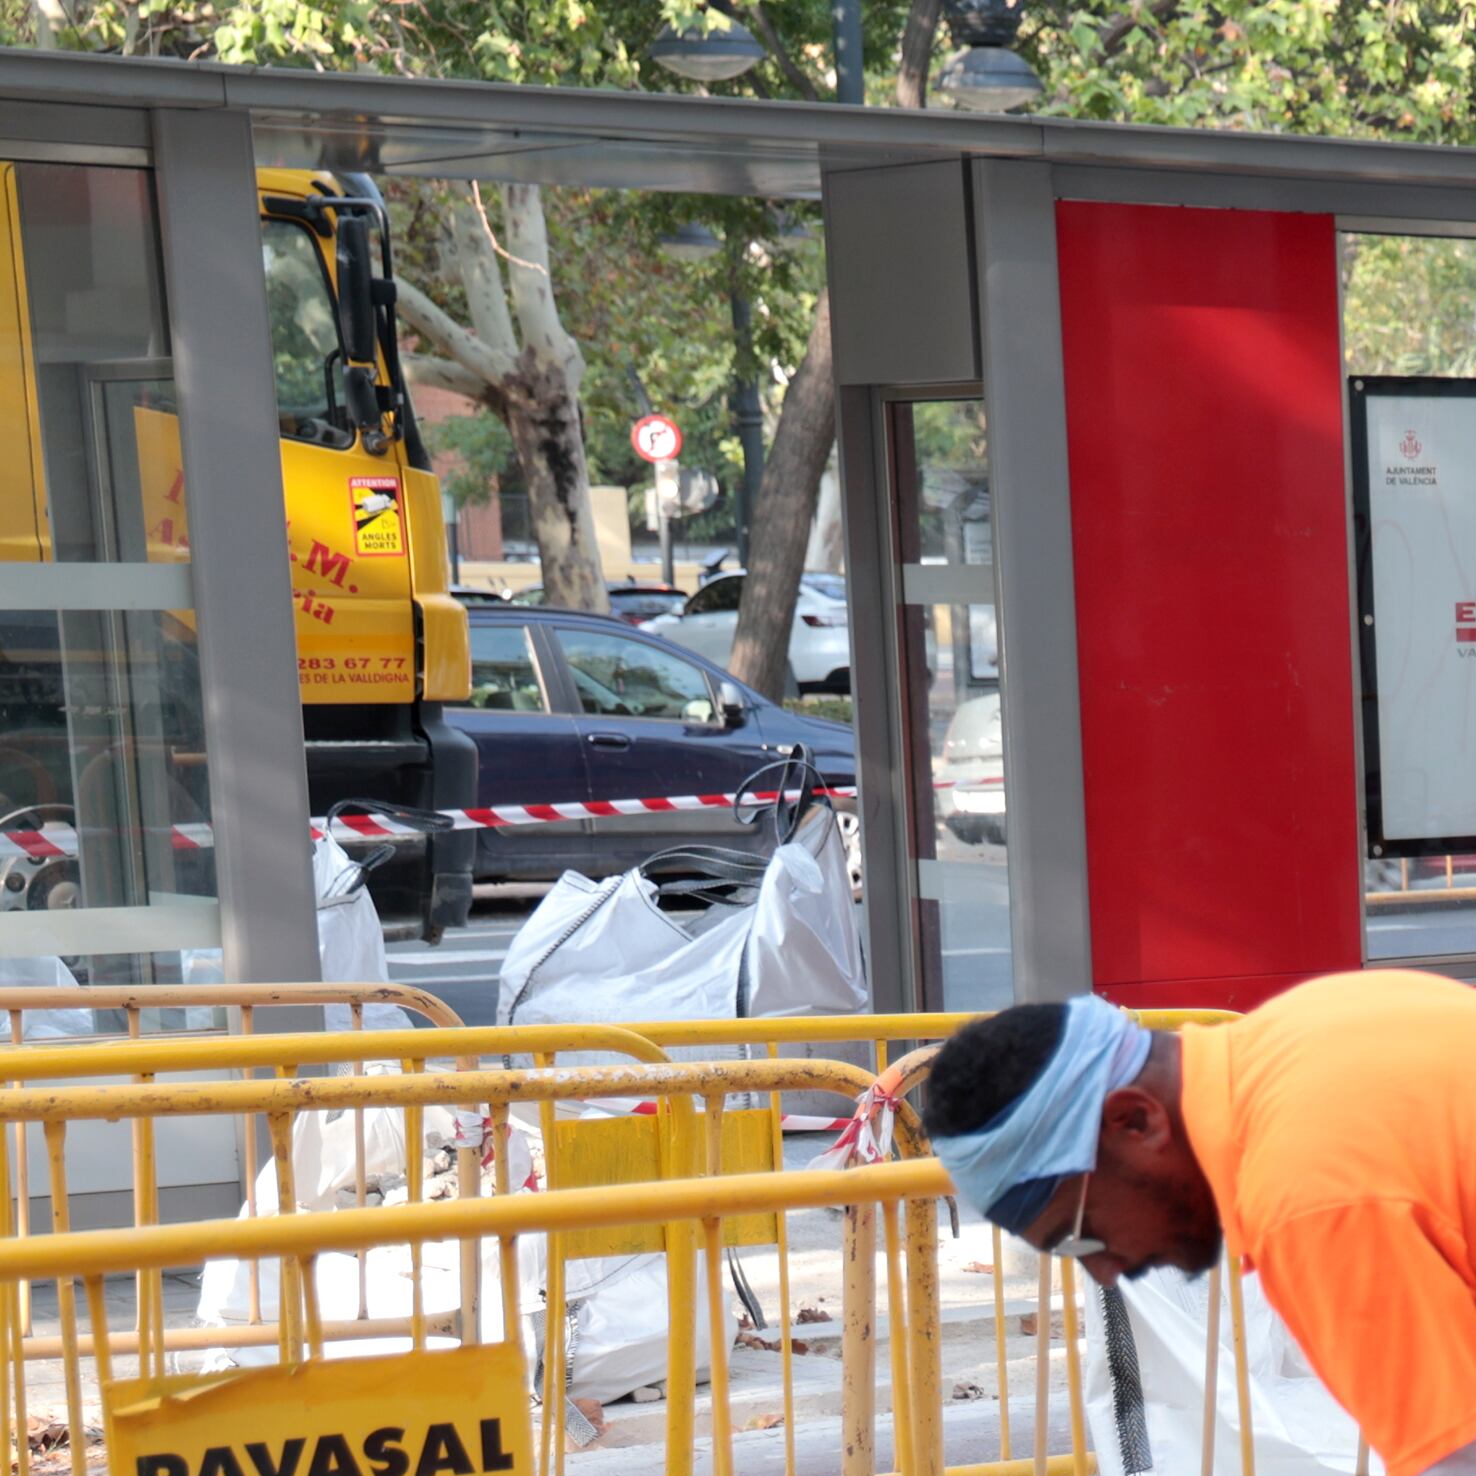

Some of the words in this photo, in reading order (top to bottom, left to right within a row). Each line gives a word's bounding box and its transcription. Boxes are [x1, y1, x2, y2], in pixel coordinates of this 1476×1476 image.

[1386, 466, 1437, 476] AJUNTAMENT
[350, 478, 397, 488] ATTENTION
[1386, 477, 1398, 486] DE
[362, 532, 397, 541] ANGLES
[364, 541, 397, 551] MORTS
[343, 657, 371, 670] 67
[379, 657, 407, 670] 77
[313, 672, 328, 684] DE
[332, 672, 347, 684] LA
[349, 672, 409, 684] VALLDIGNA
